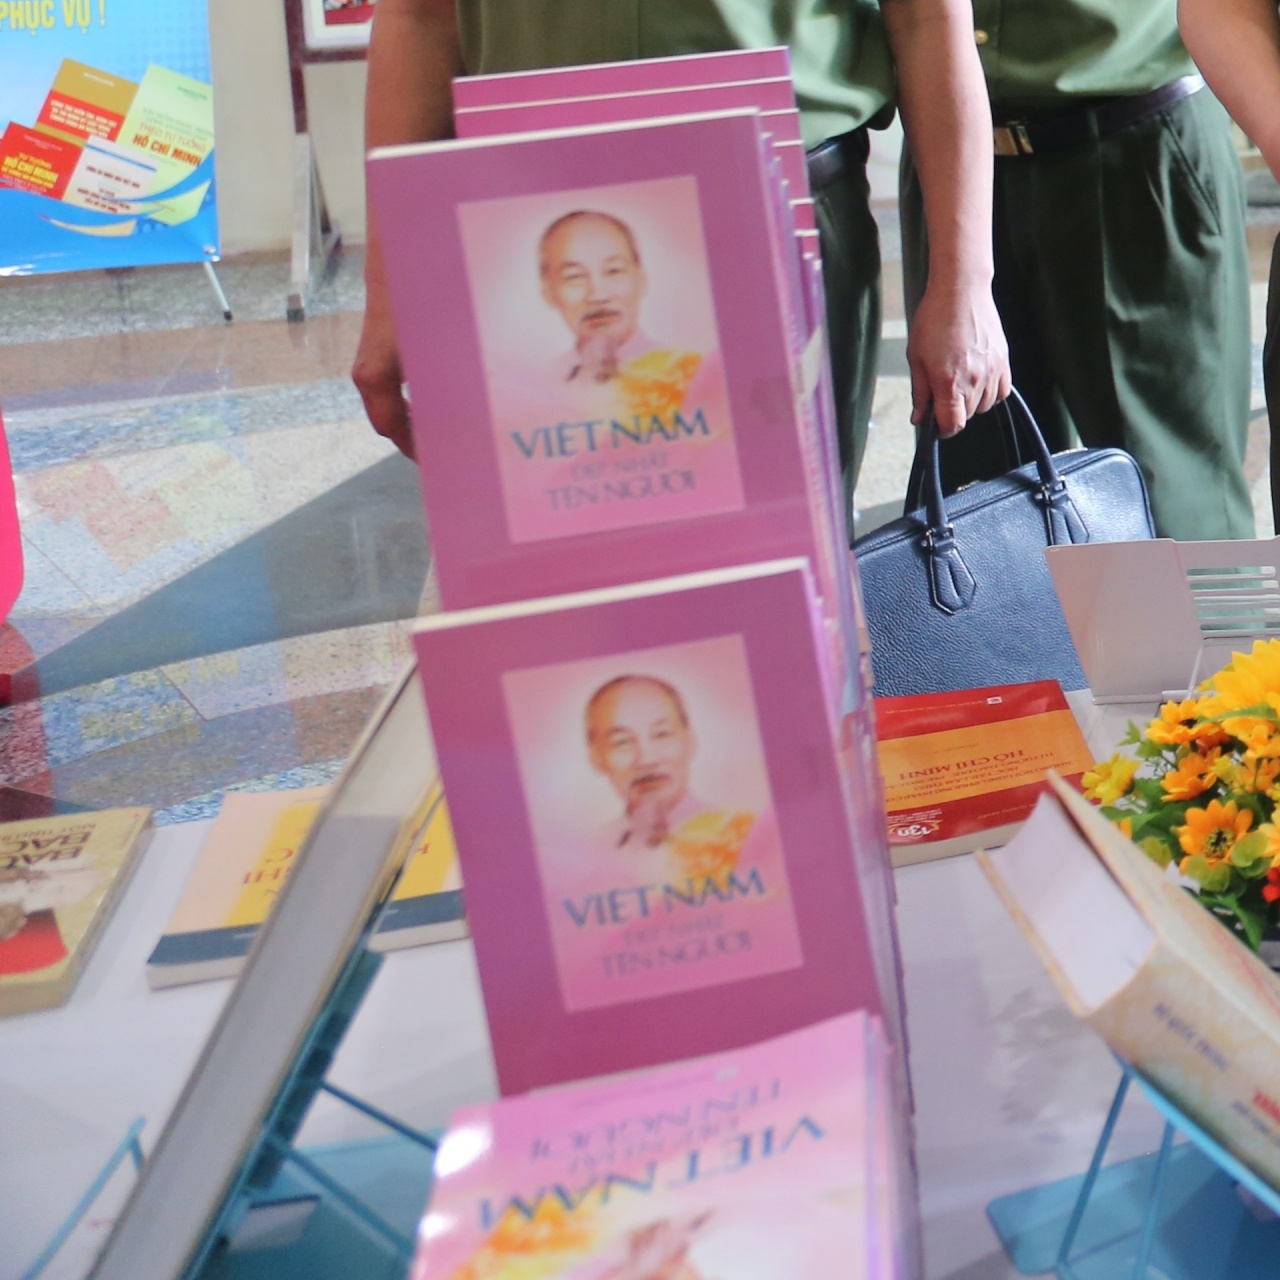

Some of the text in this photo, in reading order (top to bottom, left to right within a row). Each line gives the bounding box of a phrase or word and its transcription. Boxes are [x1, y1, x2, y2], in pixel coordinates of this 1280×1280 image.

[611, 407, 710, 449] NAM
[899, 749, 1025, 781] HỒ CHÍ MINH
[663, 867, 765, 913] NAM
